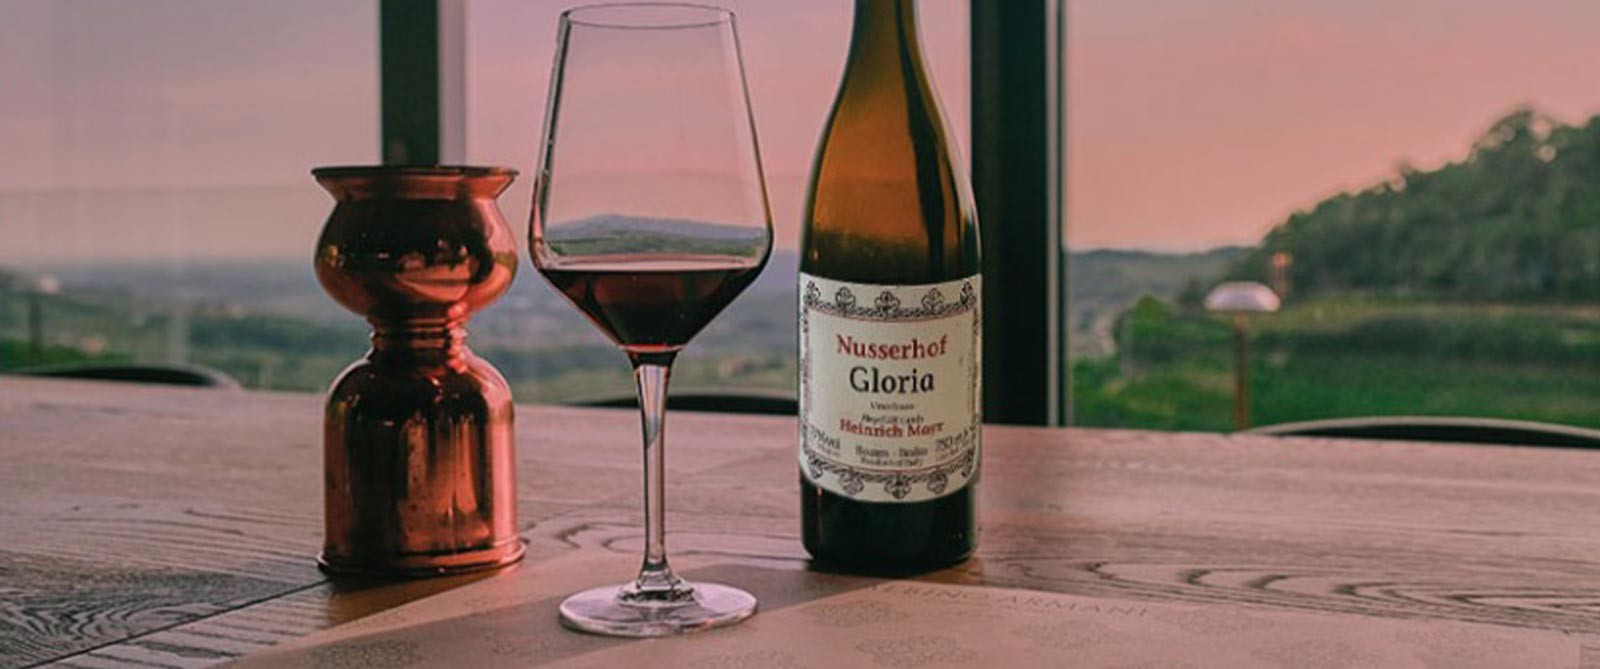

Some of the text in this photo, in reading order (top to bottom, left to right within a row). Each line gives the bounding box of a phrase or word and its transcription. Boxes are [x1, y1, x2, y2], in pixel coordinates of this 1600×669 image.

[836, 333, 948, 361] Nusserhof
[849, 365, 935, 394] Gloria
[838, 417, 903, 438] Heinrich
